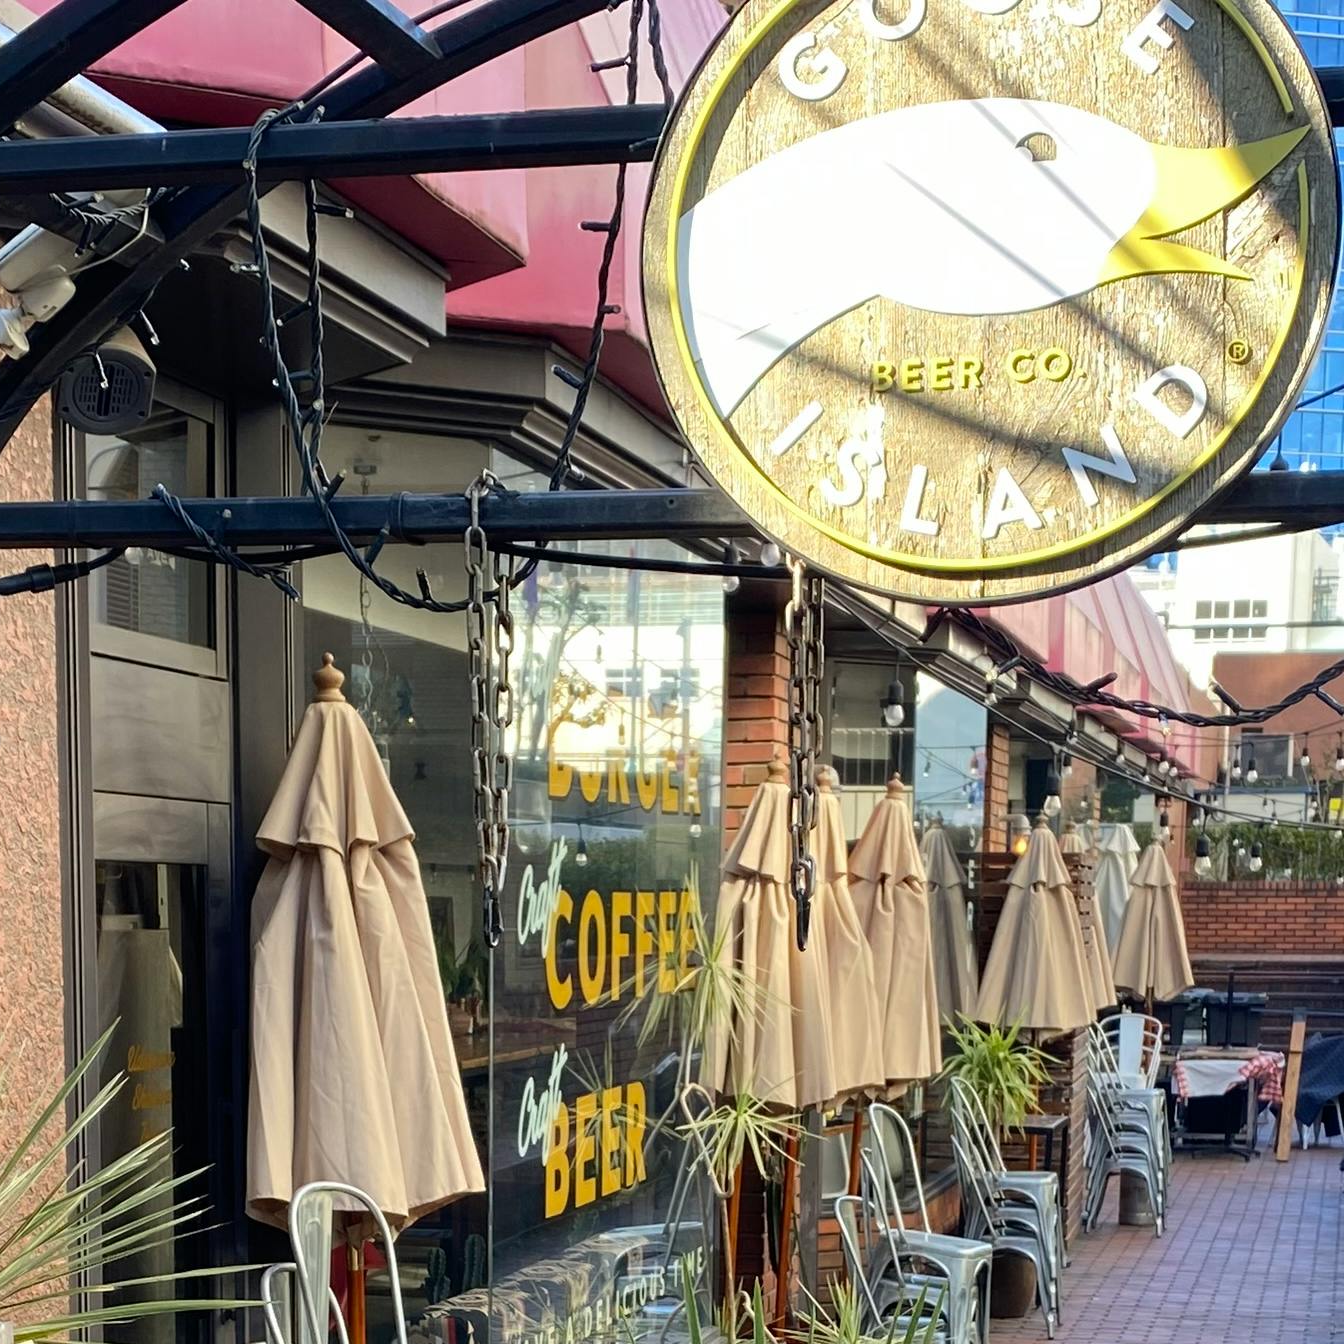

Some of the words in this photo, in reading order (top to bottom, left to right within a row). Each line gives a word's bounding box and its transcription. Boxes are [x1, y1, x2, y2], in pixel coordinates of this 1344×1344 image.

[778, 0, 1195, 101] GOE
[872, 355, 984, 393] BEER
[770, 362, 1210, 539] ISLAND
[517, 835, 569, 960] Craft
[544, 888, 698, 1010] COFFEE
[517, 1042, 569, 1167] Craft
[545, 1080, 648, 1219] BEER
